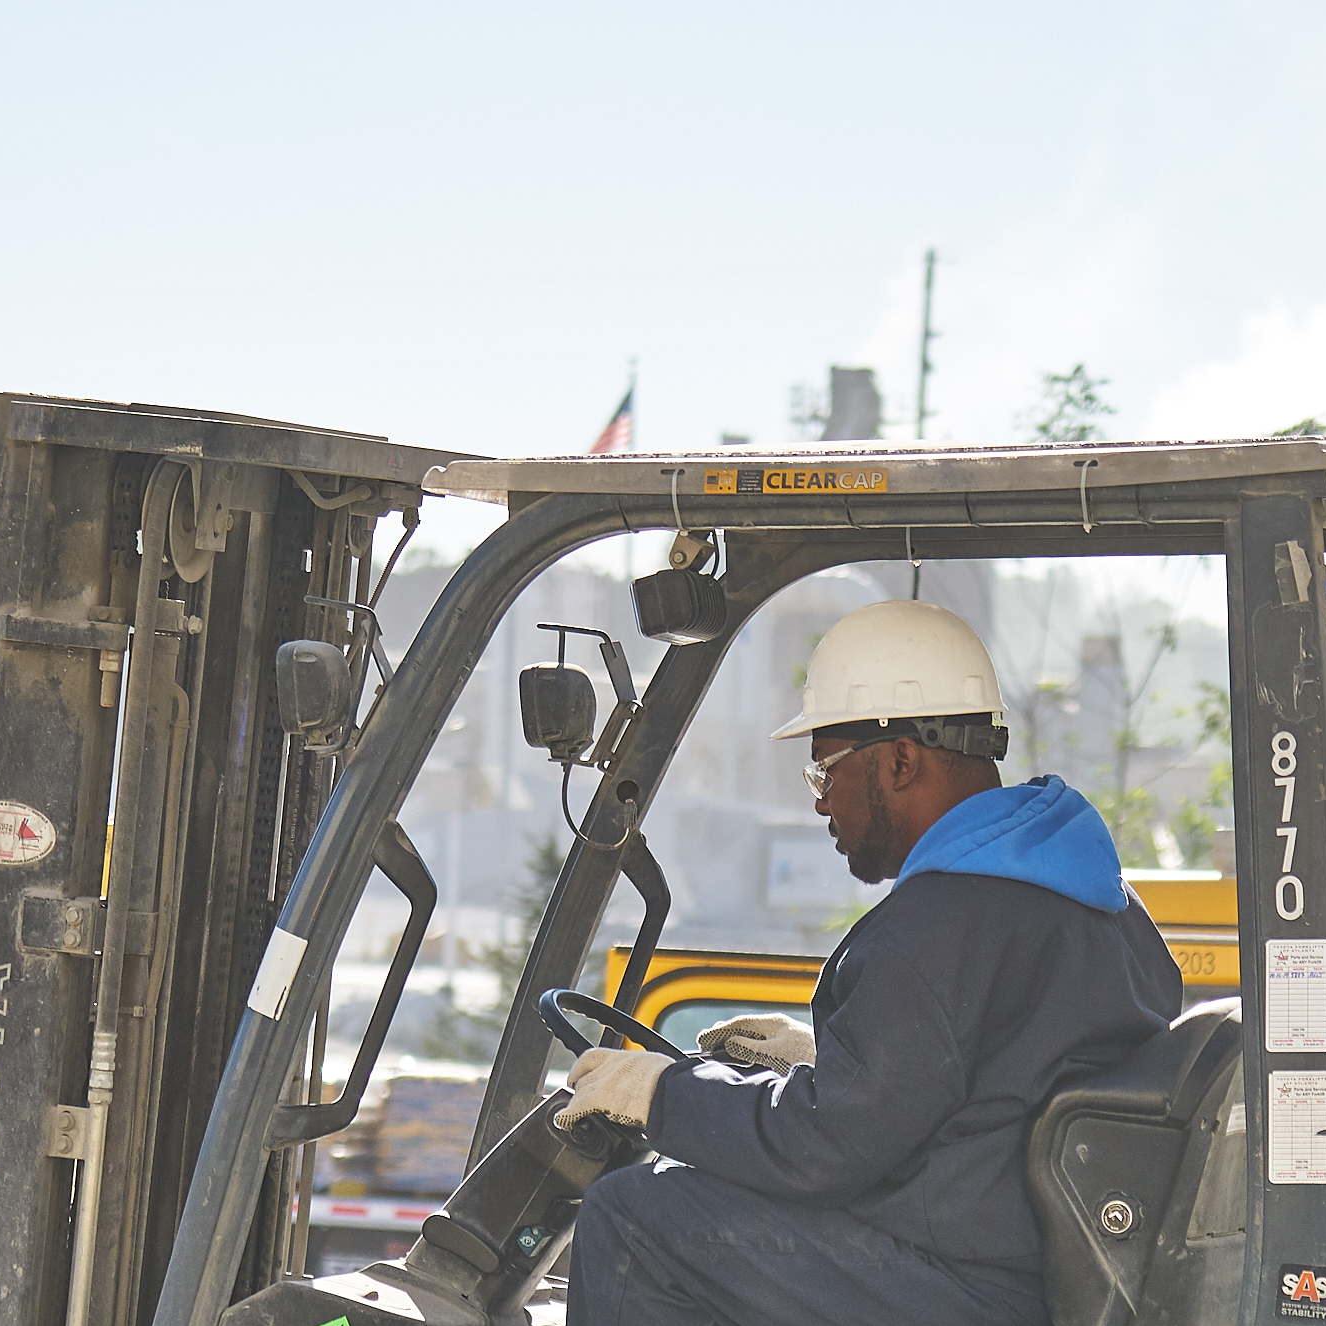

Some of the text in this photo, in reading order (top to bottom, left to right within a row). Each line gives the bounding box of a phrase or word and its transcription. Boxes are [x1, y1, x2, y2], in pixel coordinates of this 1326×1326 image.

[1271, 731, 1304, 921] 8770
[1172, 951, 1216, 975] 203
[1281, 1309, 1326, 1320] STABILITY
